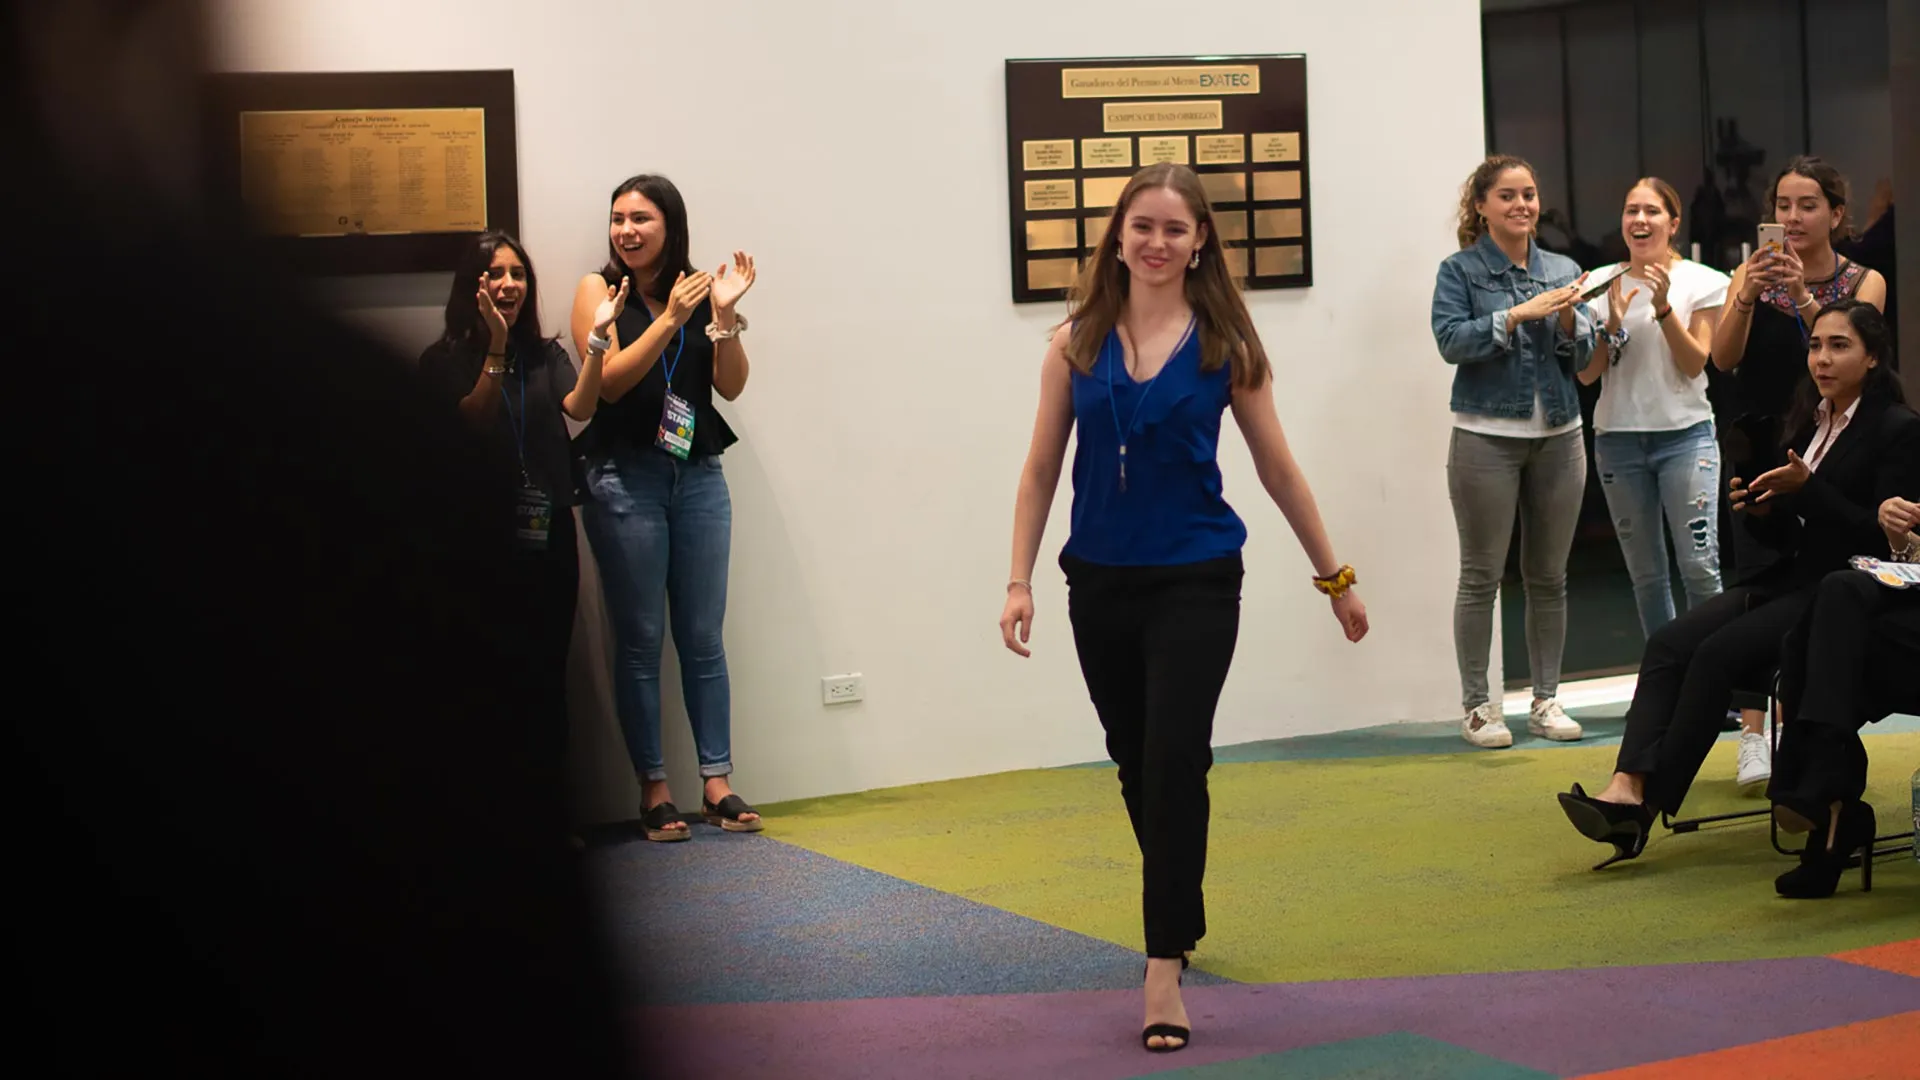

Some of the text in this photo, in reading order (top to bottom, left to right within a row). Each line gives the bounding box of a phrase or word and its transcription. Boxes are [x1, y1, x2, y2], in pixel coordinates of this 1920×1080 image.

[1070, 78, 1115, 89] Ganadores
[1116, 77, 1130, 87] del
[1131, 76, 1161, 87] Premio
[1162, 76, 1170, 86] al
[1199, 74, 1250, 87] EXATEC
[666, 410, 692, 428] STAFF
